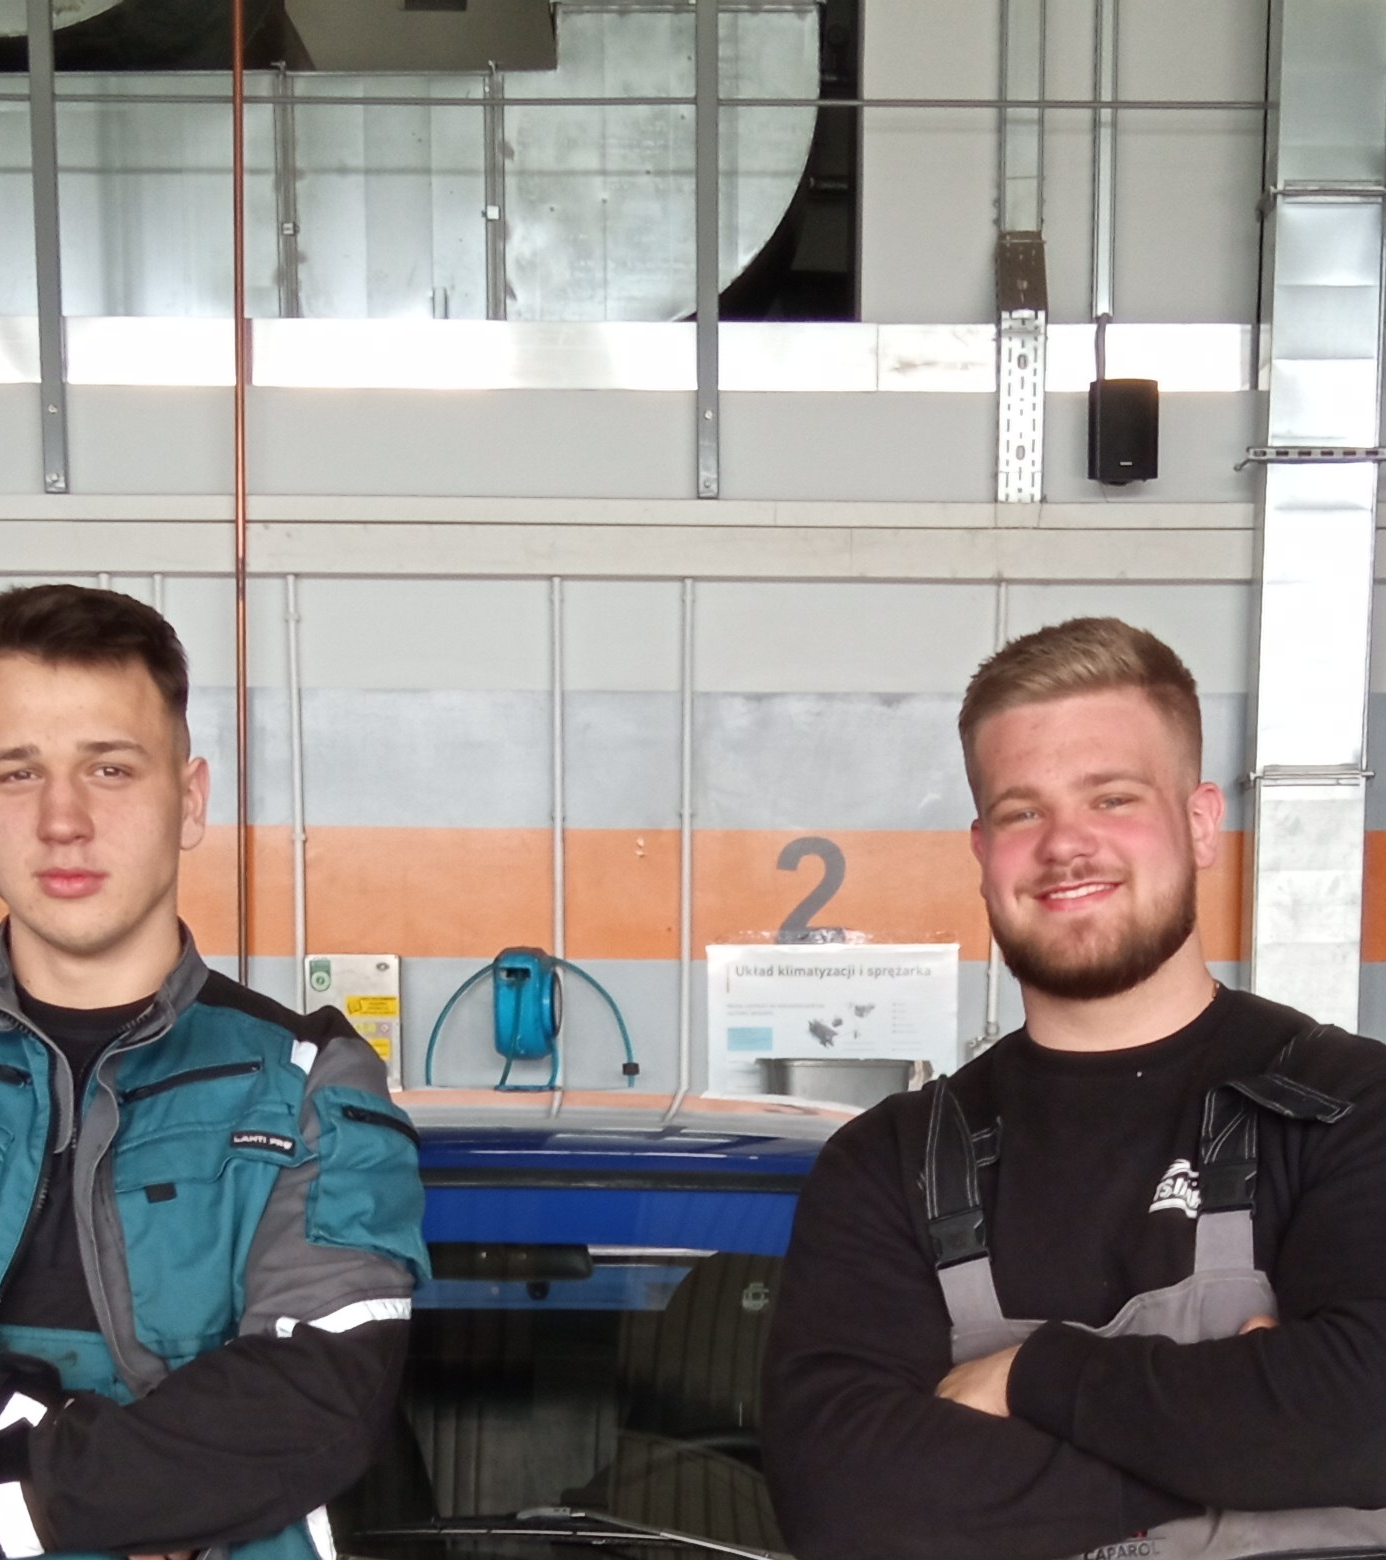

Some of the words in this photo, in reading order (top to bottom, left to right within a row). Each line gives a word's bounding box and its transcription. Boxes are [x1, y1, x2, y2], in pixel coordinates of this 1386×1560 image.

[776, 836, 846, 945] 2
[735, 965, 774, 977] Układ
[778, 965, 856, 979] klimatyzacji
